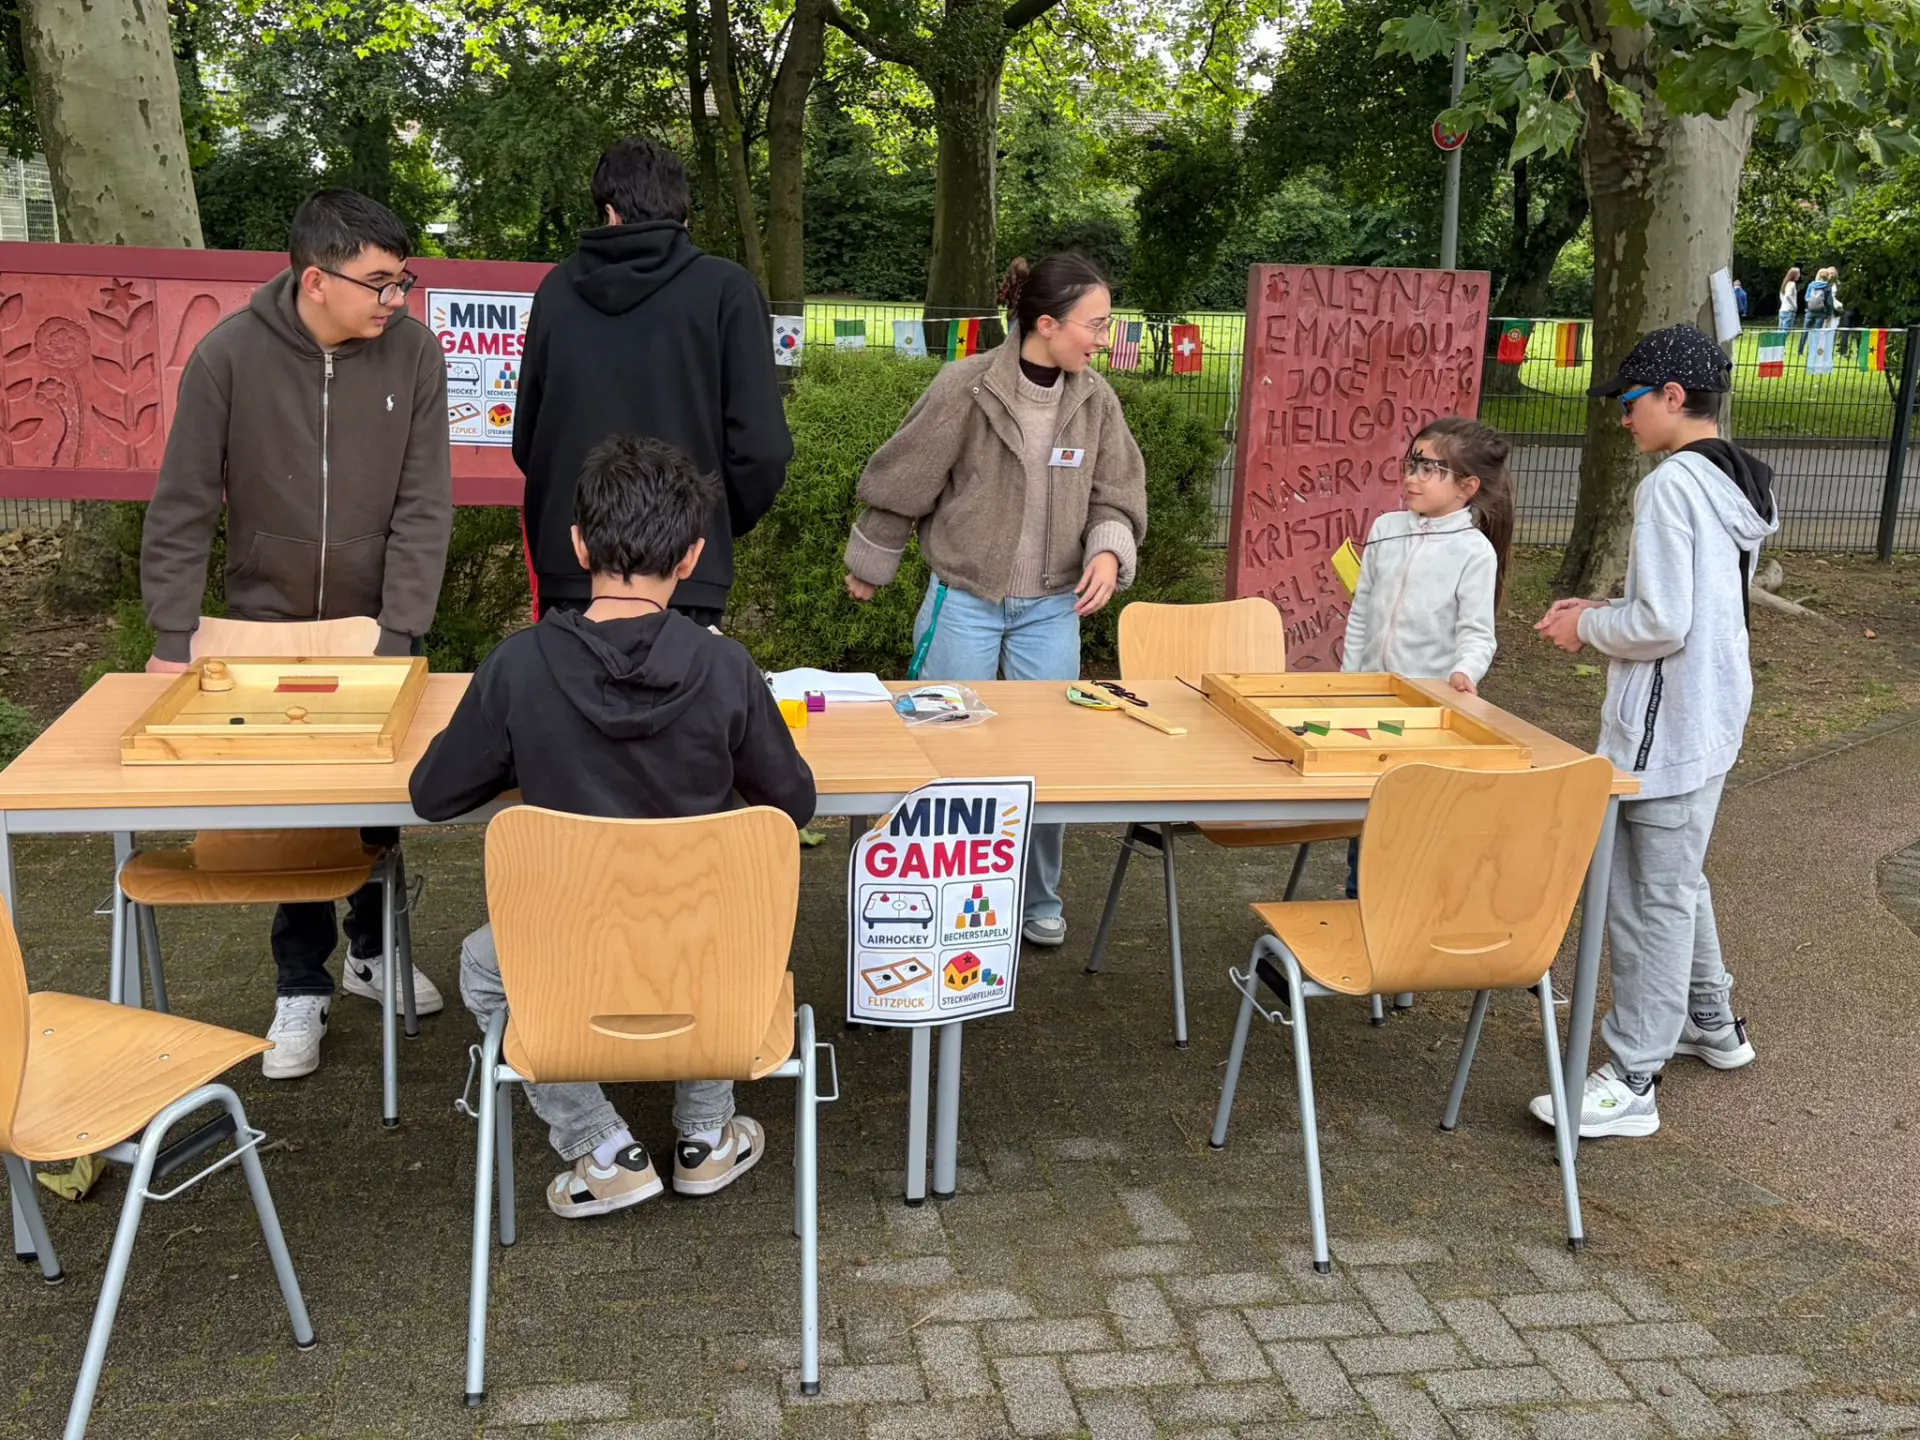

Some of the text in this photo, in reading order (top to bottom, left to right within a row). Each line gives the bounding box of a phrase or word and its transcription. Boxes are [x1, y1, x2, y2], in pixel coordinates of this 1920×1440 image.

[1299, 267, 1456, 316] ALEYNA
[449, 302, 516, 330] MINI
[437, 330, 527, 356] GAMES
[448, 388, 478, 396] RHOCKEY
[889, 797, 997, 837] MINI
[865, 838, 1015, 879] GAMES
[867, 934, 929, 945] AIRHOCKEY
[943, 927, 1009, 942] BECHERSTAPELN
[867, 996, 925, 1009] FLITZPUCK
[941, 986, 1005, 1006] STECKWÜRFELHAUS
